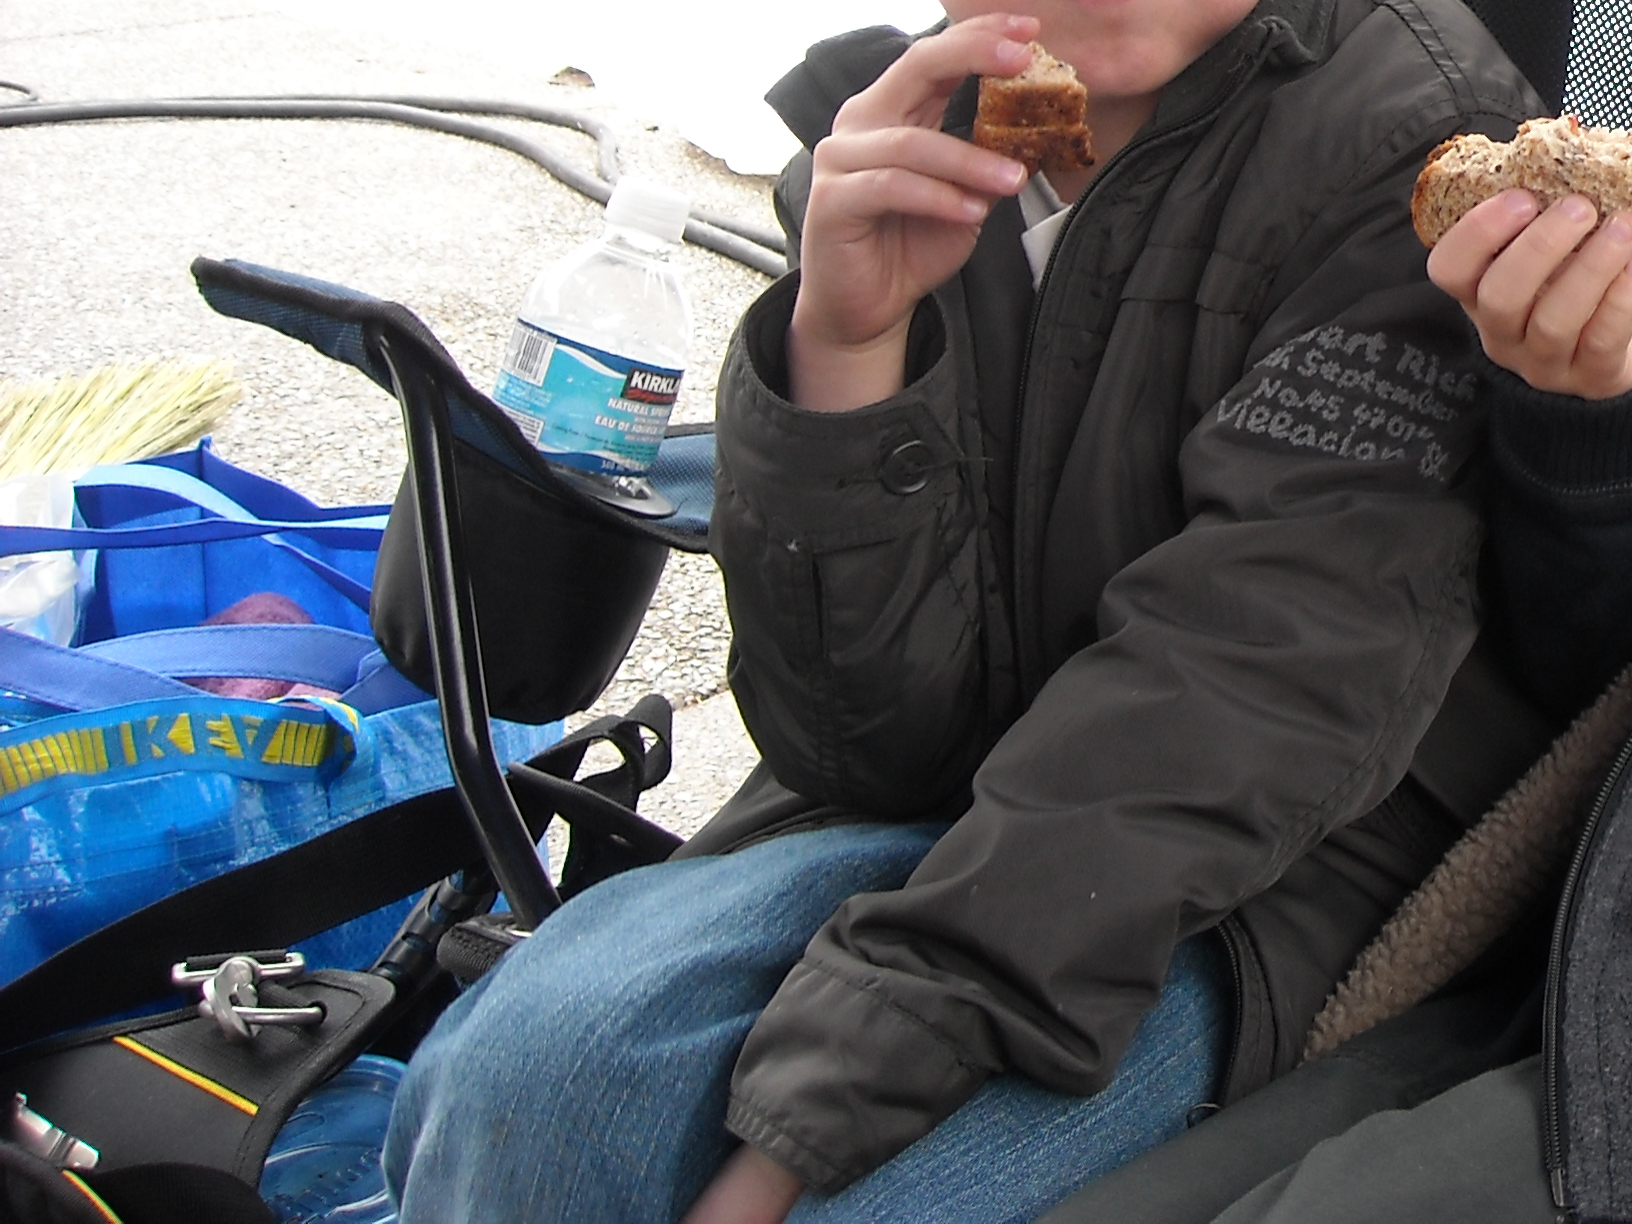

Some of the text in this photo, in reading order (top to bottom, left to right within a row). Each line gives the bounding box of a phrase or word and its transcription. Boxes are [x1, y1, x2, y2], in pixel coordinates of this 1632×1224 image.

[1297, 348, 1459, 423] September
[607, 398, 649, 415] NATURAL
[594, 415, 617, 428] EAU
